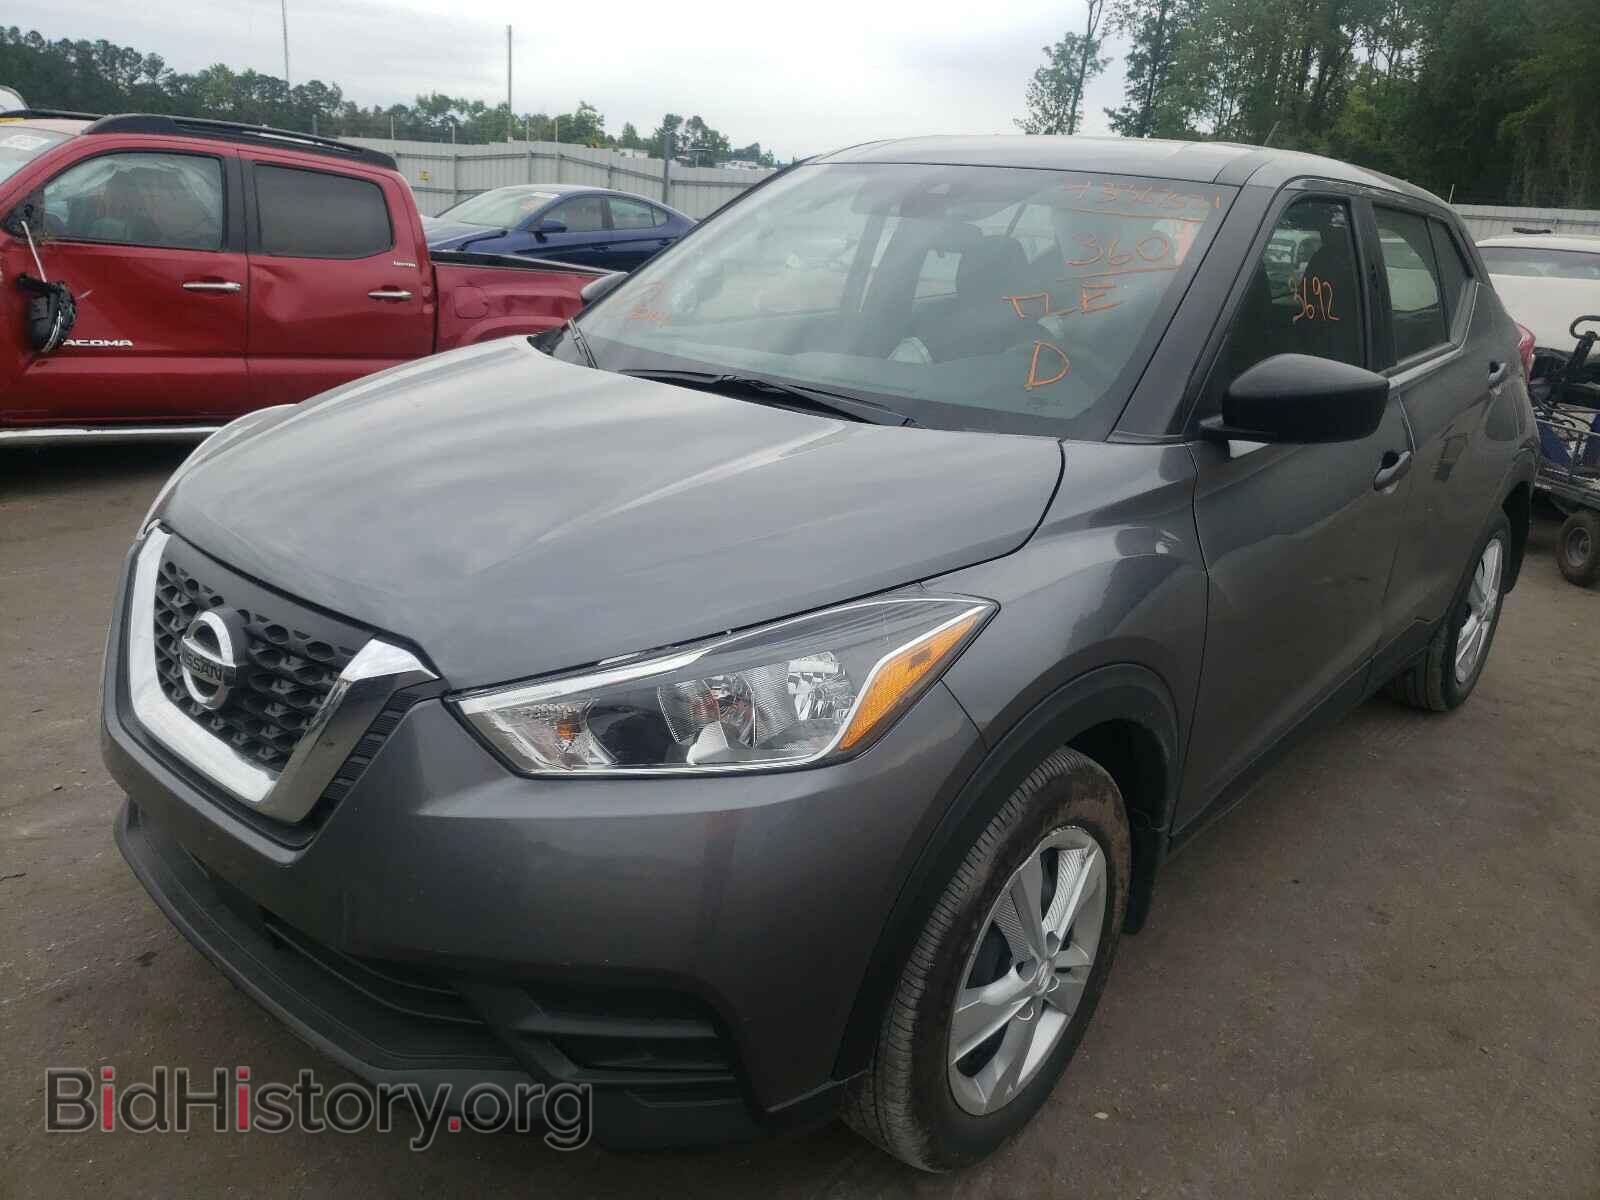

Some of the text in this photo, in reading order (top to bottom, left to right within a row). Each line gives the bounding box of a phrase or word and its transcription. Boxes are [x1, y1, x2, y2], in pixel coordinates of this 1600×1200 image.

[1066, 229, 1170, 266] 360
[61, 339, 134, 347] ACOMA
[1024, 340, 1070, 391] D
